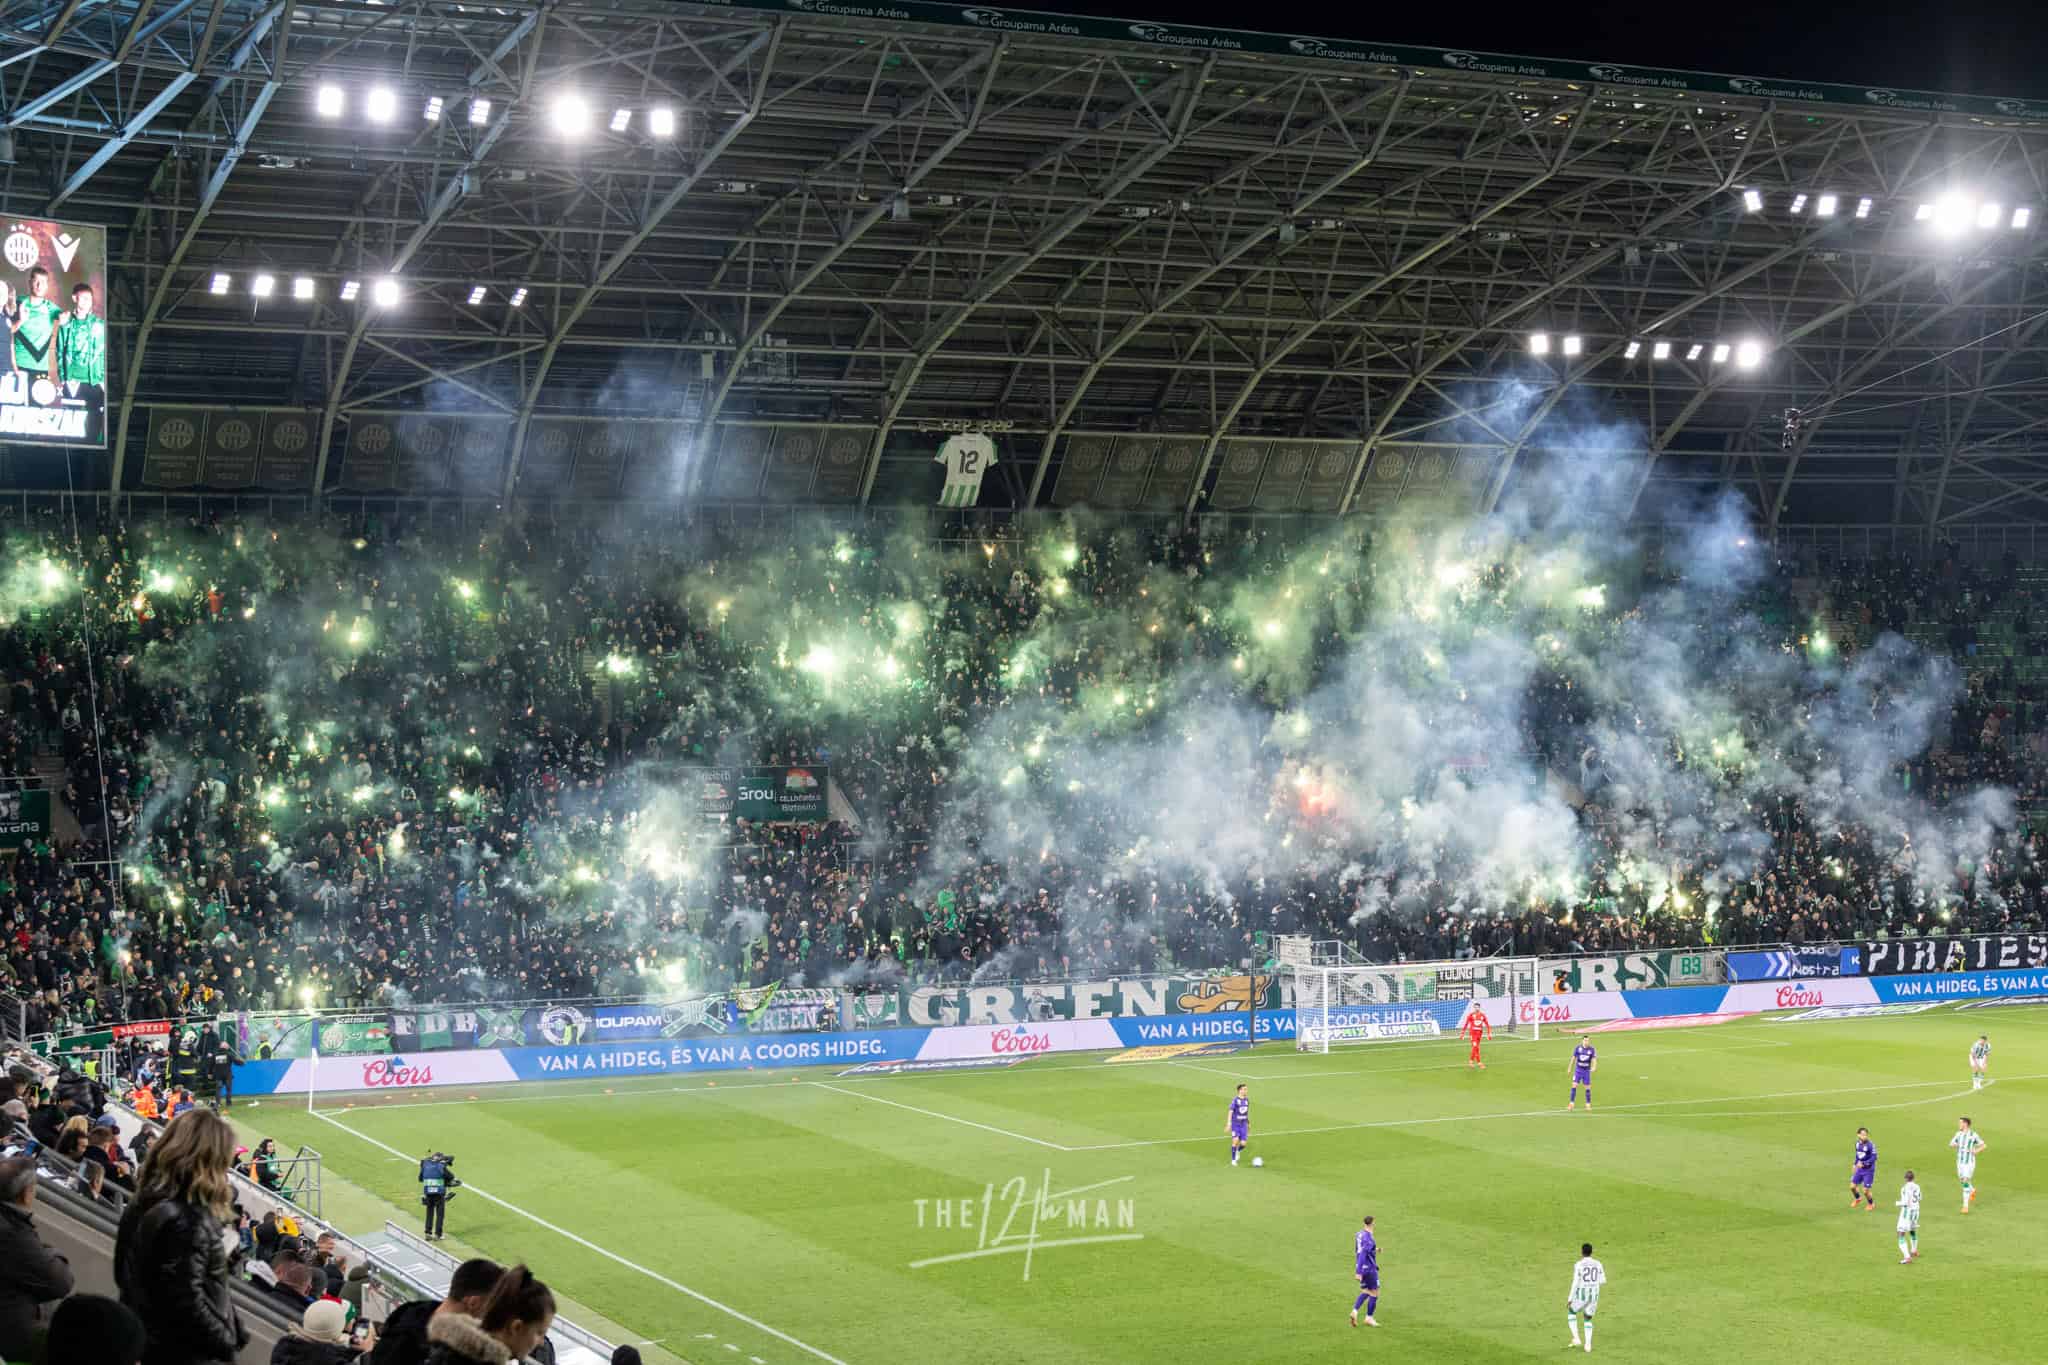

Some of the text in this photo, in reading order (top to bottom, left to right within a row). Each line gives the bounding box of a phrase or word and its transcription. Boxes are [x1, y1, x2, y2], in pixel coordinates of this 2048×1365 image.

[815, 2, 910, 18] Groupama Aréna
[990, 17, 1079, 35] Groupama Aréna
[1156, 32, 1241, 49] Groupama Aréna
[1315, 46, 1367, 61] Groupama
[959, 449, 978, 474] 12
[1681, 956, 1702, 976] B3
[1893, 981, 1921, 996] VAN
[1924, 981, 1934, 994] A
[1936, 977, 1981, 995] HIDEG,
[1983, 974, 1998, 991] ÉS
[2001, 976, 2028, 990] VAN
[2030, 977, 2040, 989] A
[908, 978, 1170, 1026] GREEN
[1776, 985, 1824, 1008] Coors
[1138, 1023, 1173, 1040] VAN
[1176, 1022, 1188, 1038] A
[1193, 1017, 1249, 1038] HIDEG,
[1252, 1012, 1271, 1034] ÉS
[990, 1028, 1051, 1053] Coors
[538, 1038, 887, 1073] VAN A HIDEG, ÉS VAN A COORS HIDEG.
[363, 1059, 433, 1088] Coors
[1583, 1267, 1598, 1282] 20
